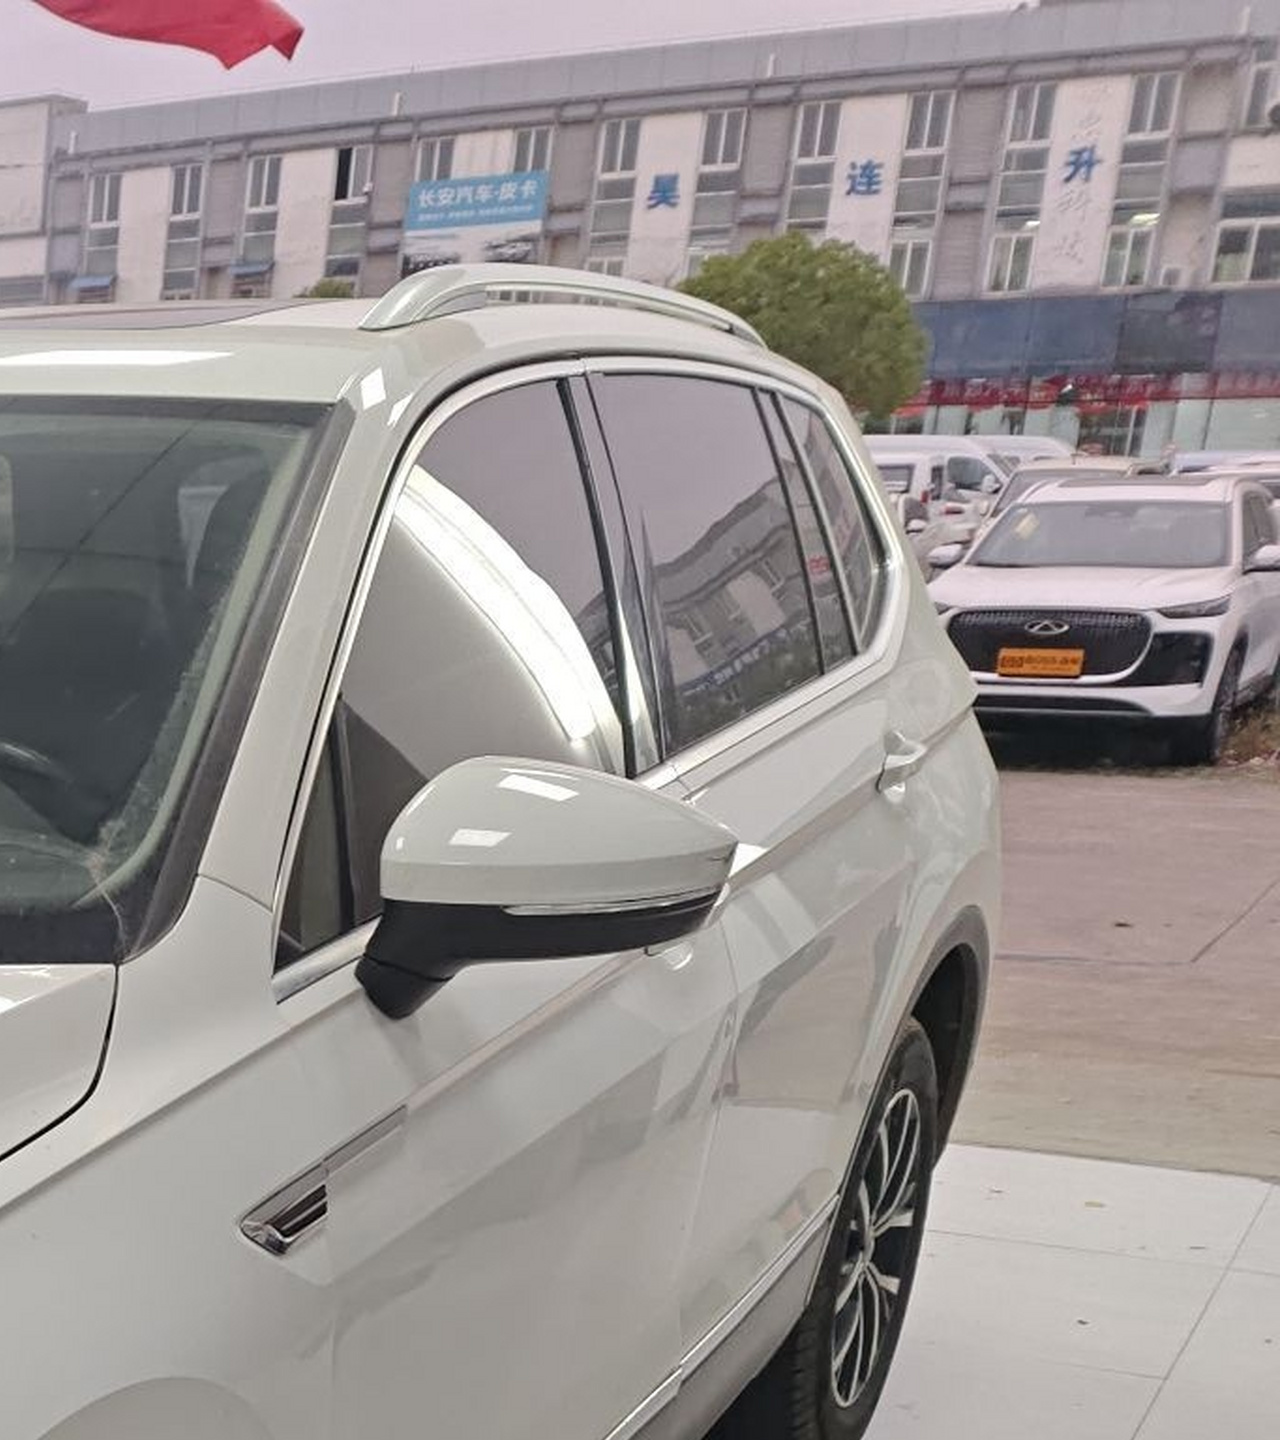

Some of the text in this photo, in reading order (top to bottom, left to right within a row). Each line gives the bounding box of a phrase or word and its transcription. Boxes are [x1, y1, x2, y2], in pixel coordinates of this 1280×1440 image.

[418, 179, 538, 208] 长安汽车·皮卡
[844, 160, 886, 197] 连
